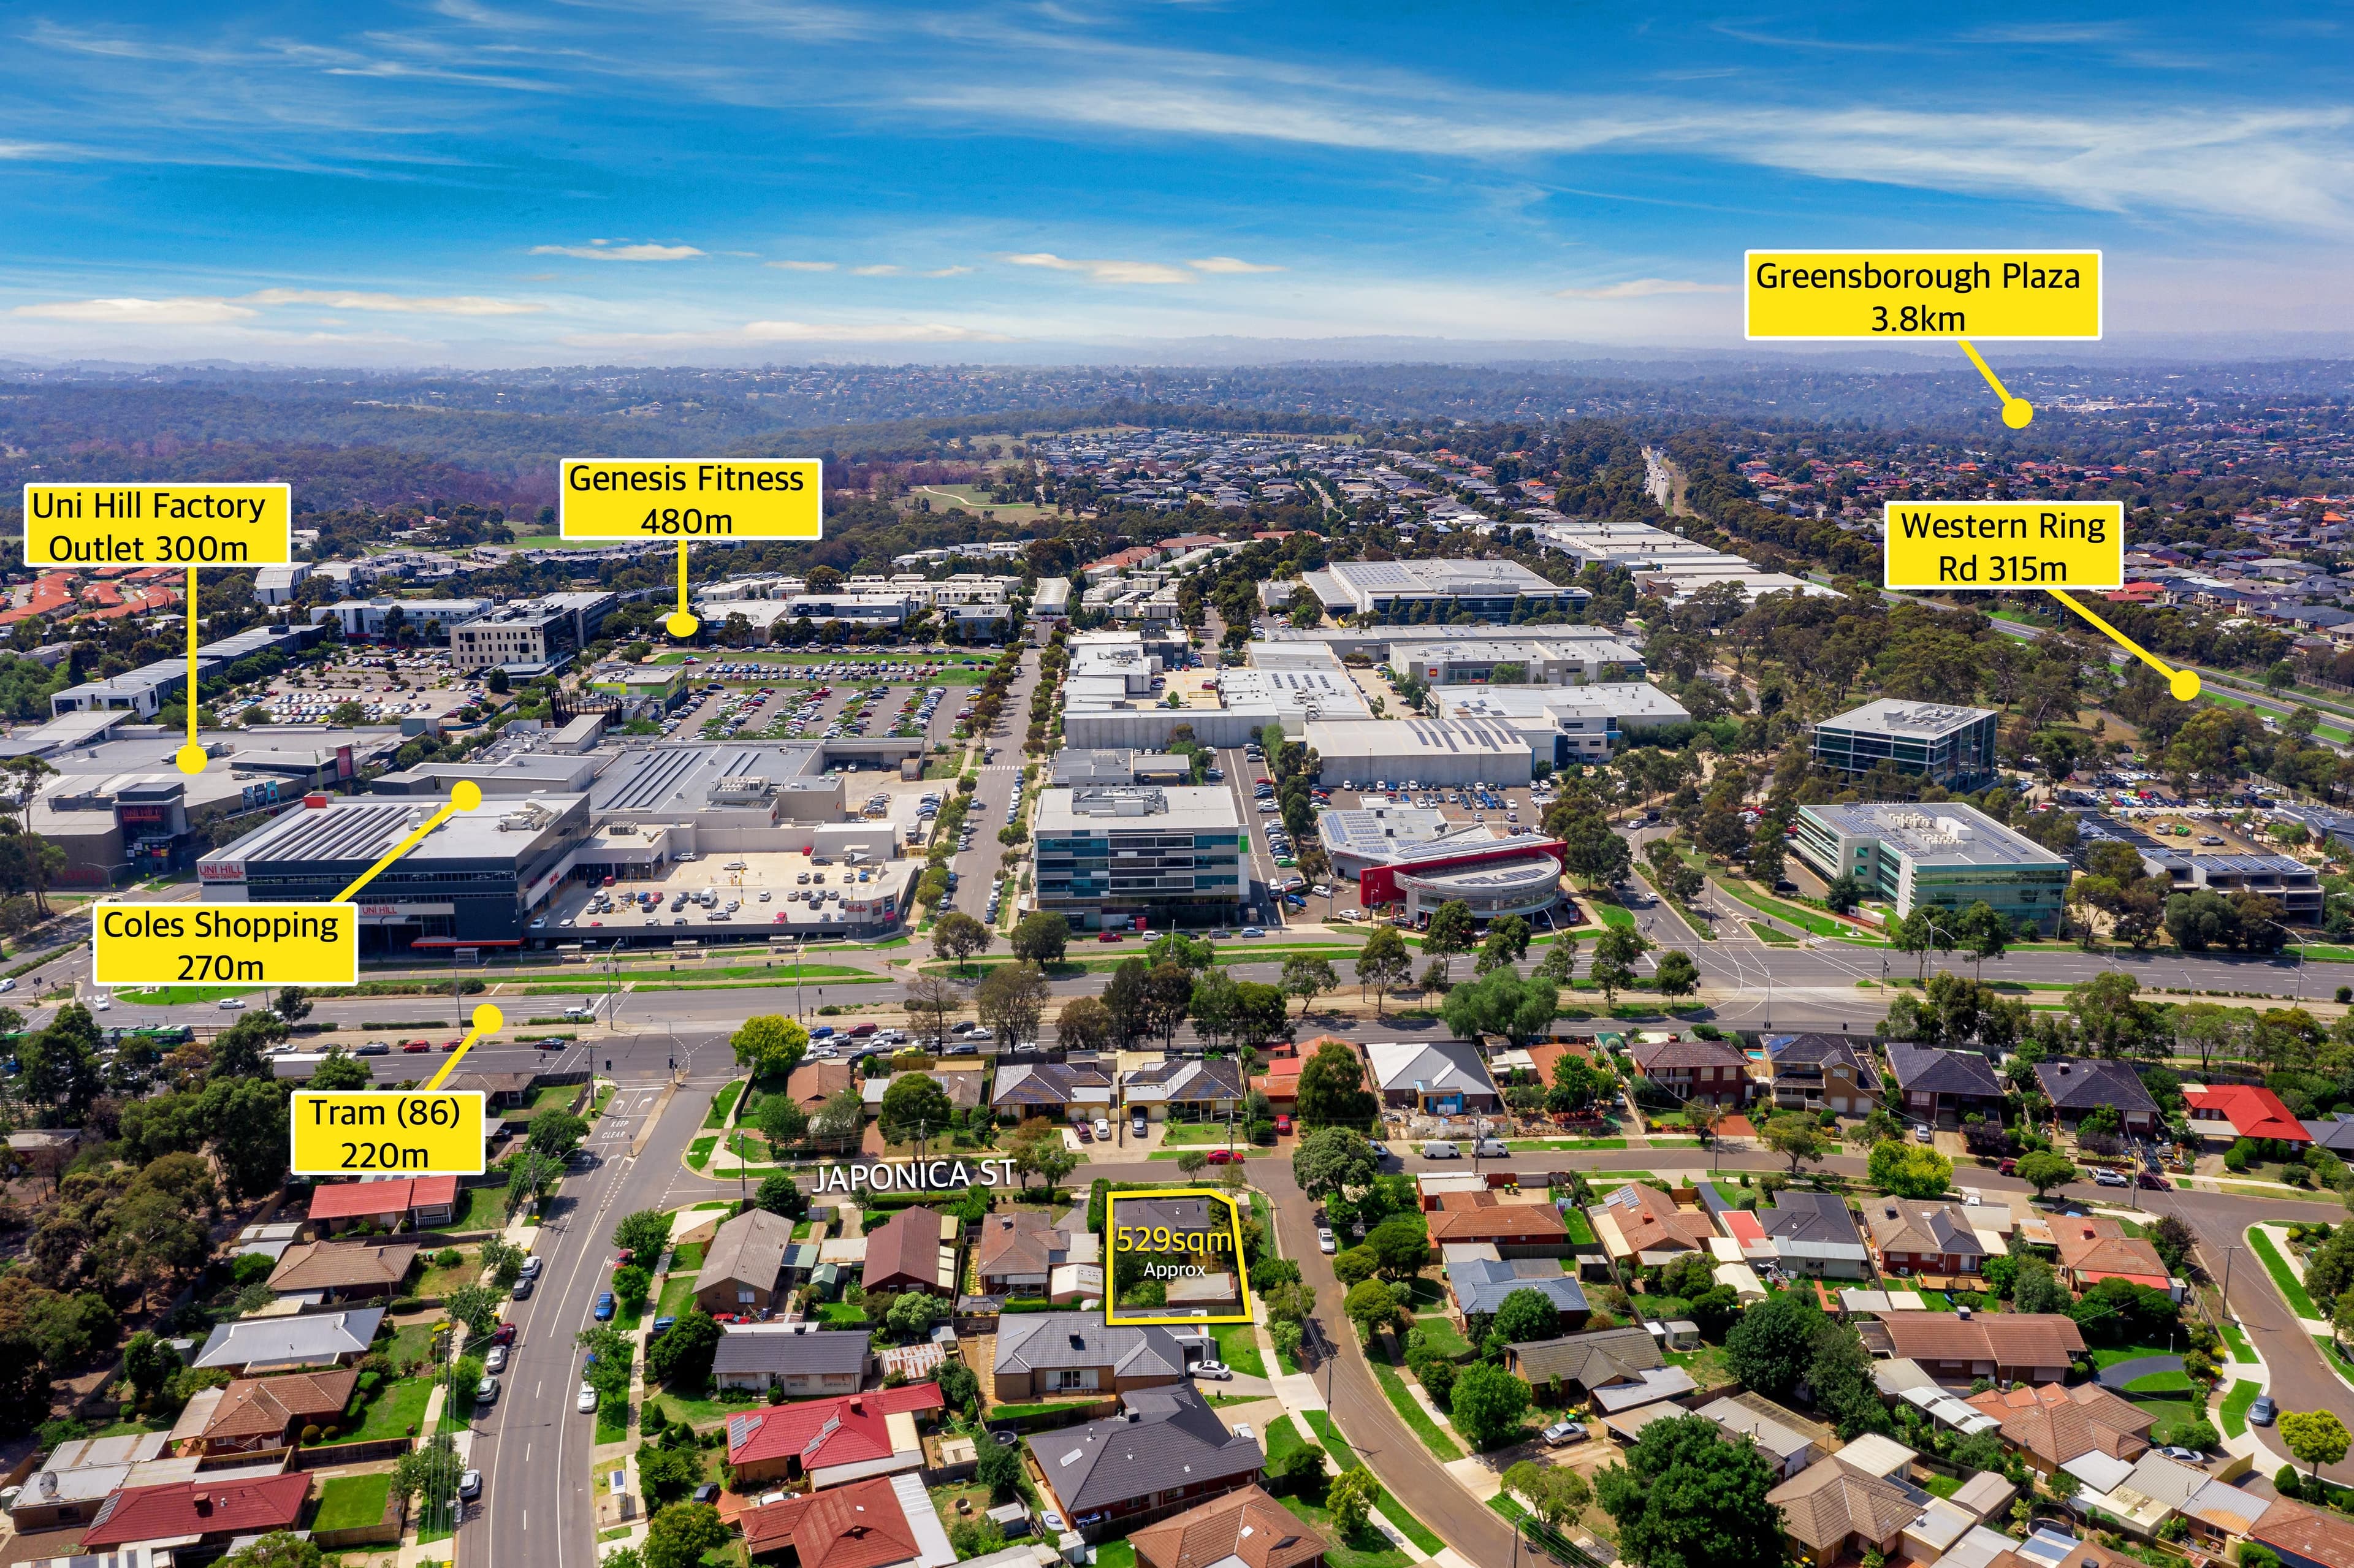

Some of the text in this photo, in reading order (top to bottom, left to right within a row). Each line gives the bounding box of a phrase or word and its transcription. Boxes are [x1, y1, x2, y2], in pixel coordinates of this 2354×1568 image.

[199, 863, 243, 874] UNI HILL
[1412, 881, 1438, 890] HONDA
[362, 905, 397, 913] UNI HILL
